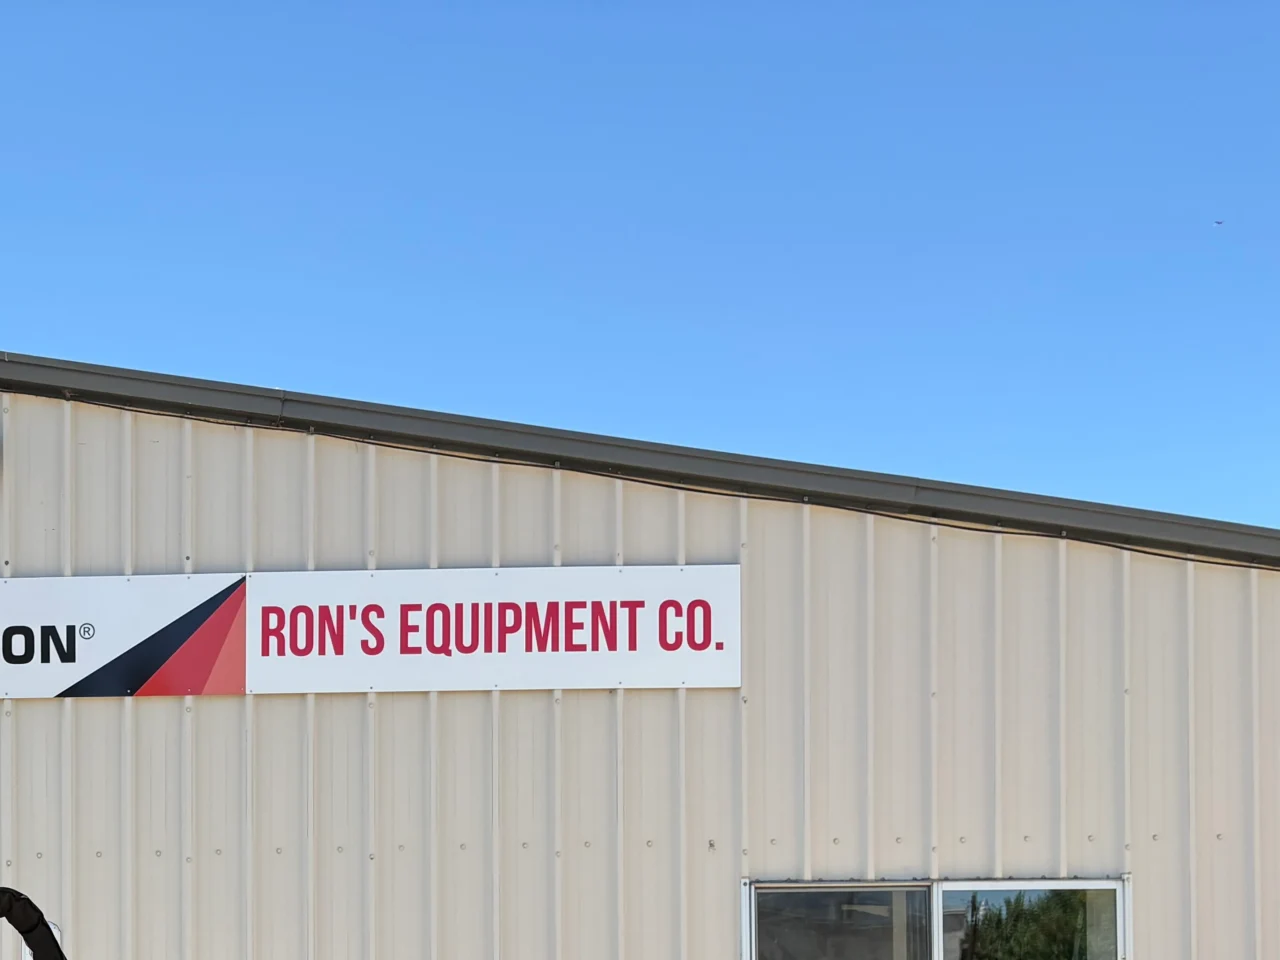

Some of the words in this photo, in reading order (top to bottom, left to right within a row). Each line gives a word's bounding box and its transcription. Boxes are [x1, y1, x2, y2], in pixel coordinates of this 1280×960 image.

[260, 604, 386, 657] RON'S
[400, 600, 646, 657] EQUIPMENT
[658, 598, 725, 652] CO.
